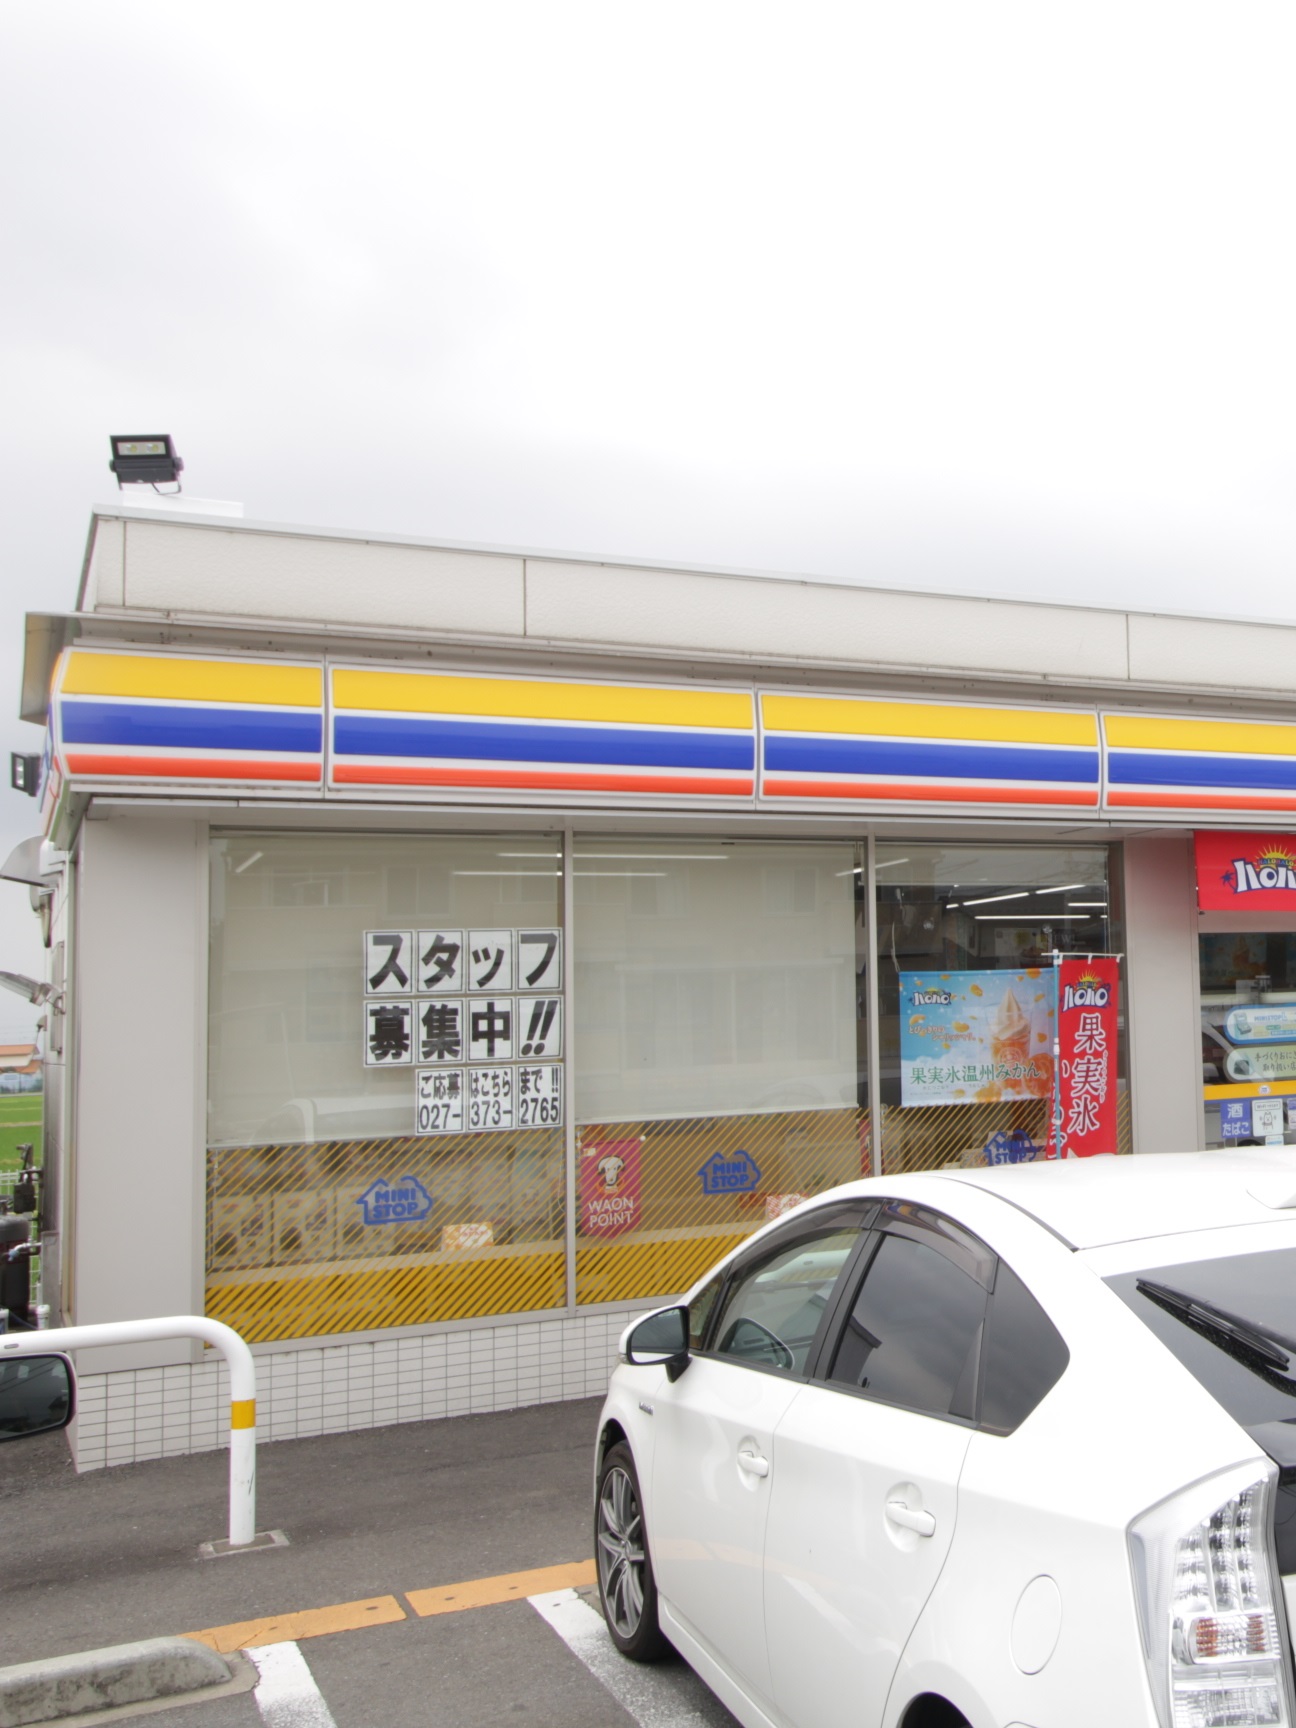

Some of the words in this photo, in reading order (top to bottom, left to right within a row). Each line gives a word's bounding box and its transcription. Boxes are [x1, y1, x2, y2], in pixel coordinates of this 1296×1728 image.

[368, 932, 558, 991] スタッフ
[368, 1000, 559, 1061] 募集中!!
[909, 1061, 1041, 1086] 果実氷温州みかん
[1067, 1012, 1106, 1137] 果実氷
[419, 1096, 559, 1130] 027-373-2765
[1227, 1102, 1244, 1119] 酒
[1222, 1121, 1250, 1137] たばこ
[711, 1160, 748, 1176] MINI
[711, 1173, 750, 1189] STOP
[374, 1186, 418, 1204] MINI
[373, 1202, 420, 1219] STOP
[588, 1197, 635, 1214] WAON
[588, 1211, 635, 1228] POINT
